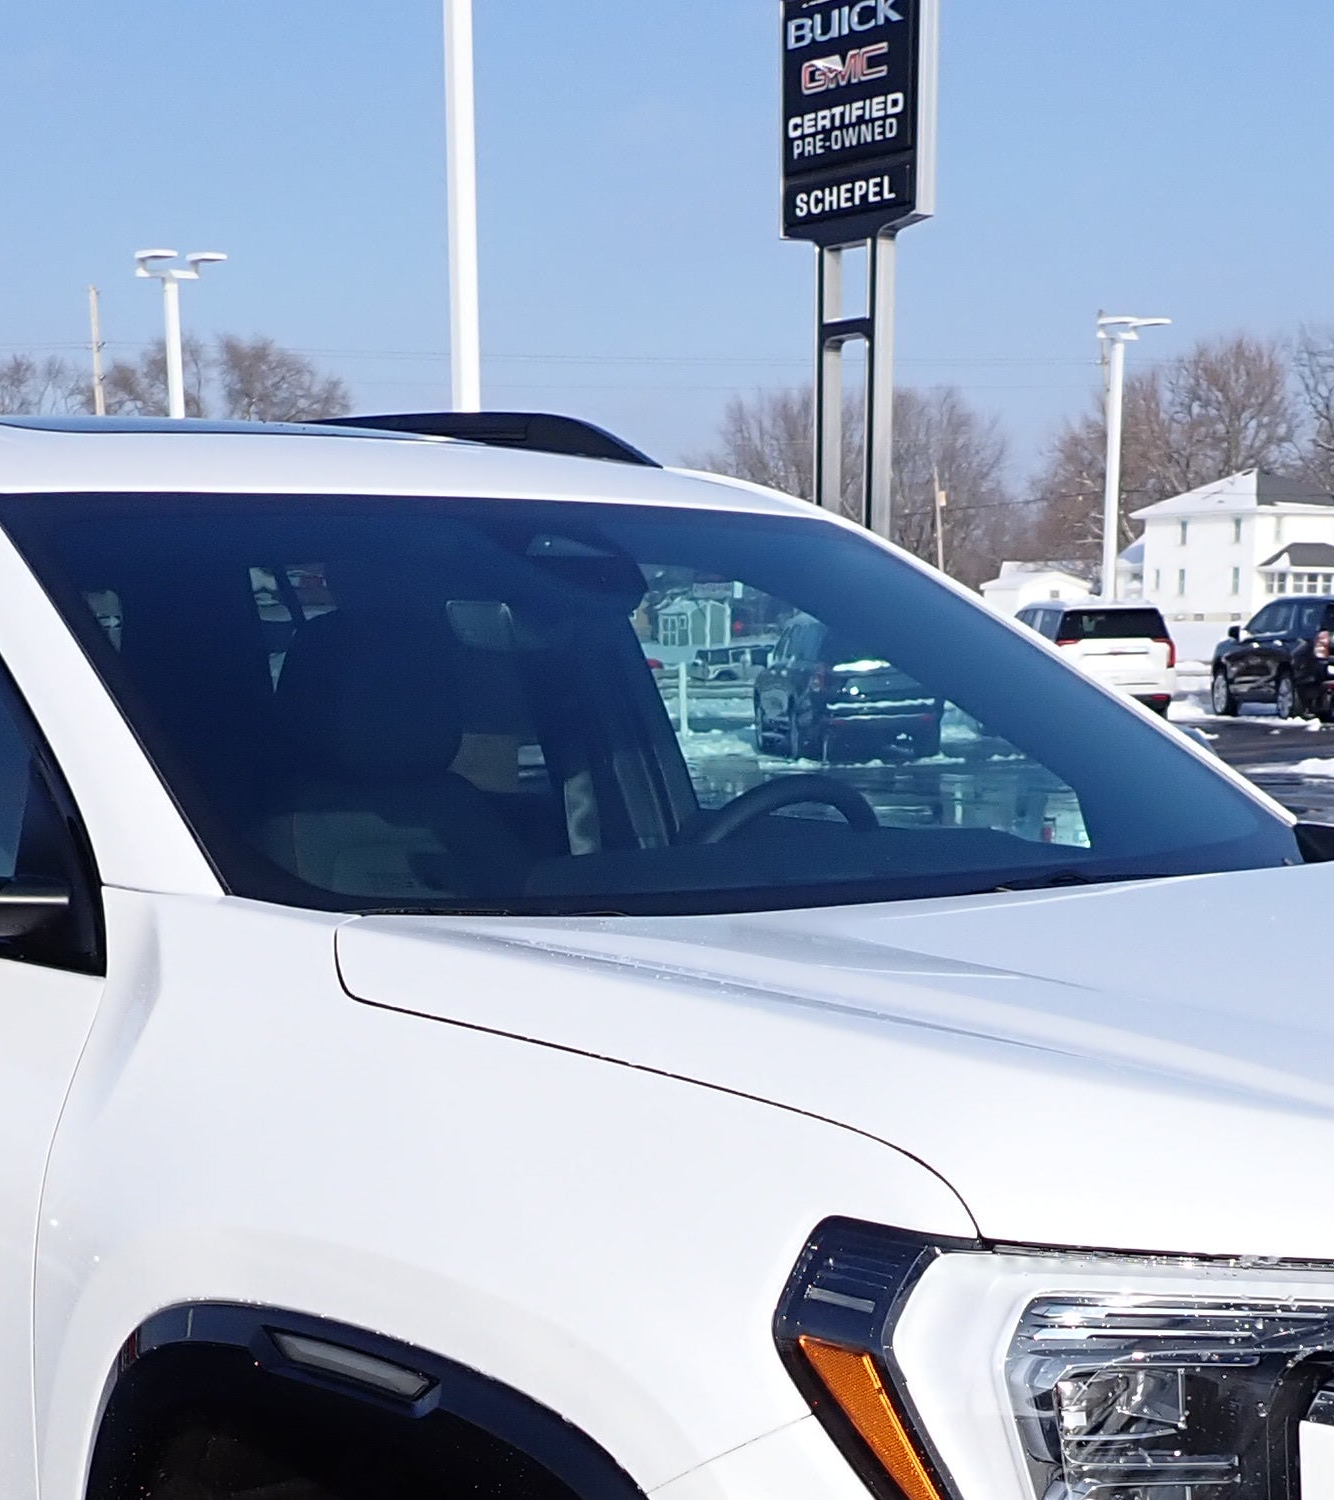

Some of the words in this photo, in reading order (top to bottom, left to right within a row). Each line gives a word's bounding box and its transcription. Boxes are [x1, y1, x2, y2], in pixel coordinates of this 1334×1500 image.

[786, 0, 905, 50] BUICK
[801, 41, 889, 96] GMC
[787, 91, 905, 139] CERTIFIED
[793, 117, 898, 160] PRE-OWNED
[794, 175, 897, 218] SCHEPEL
